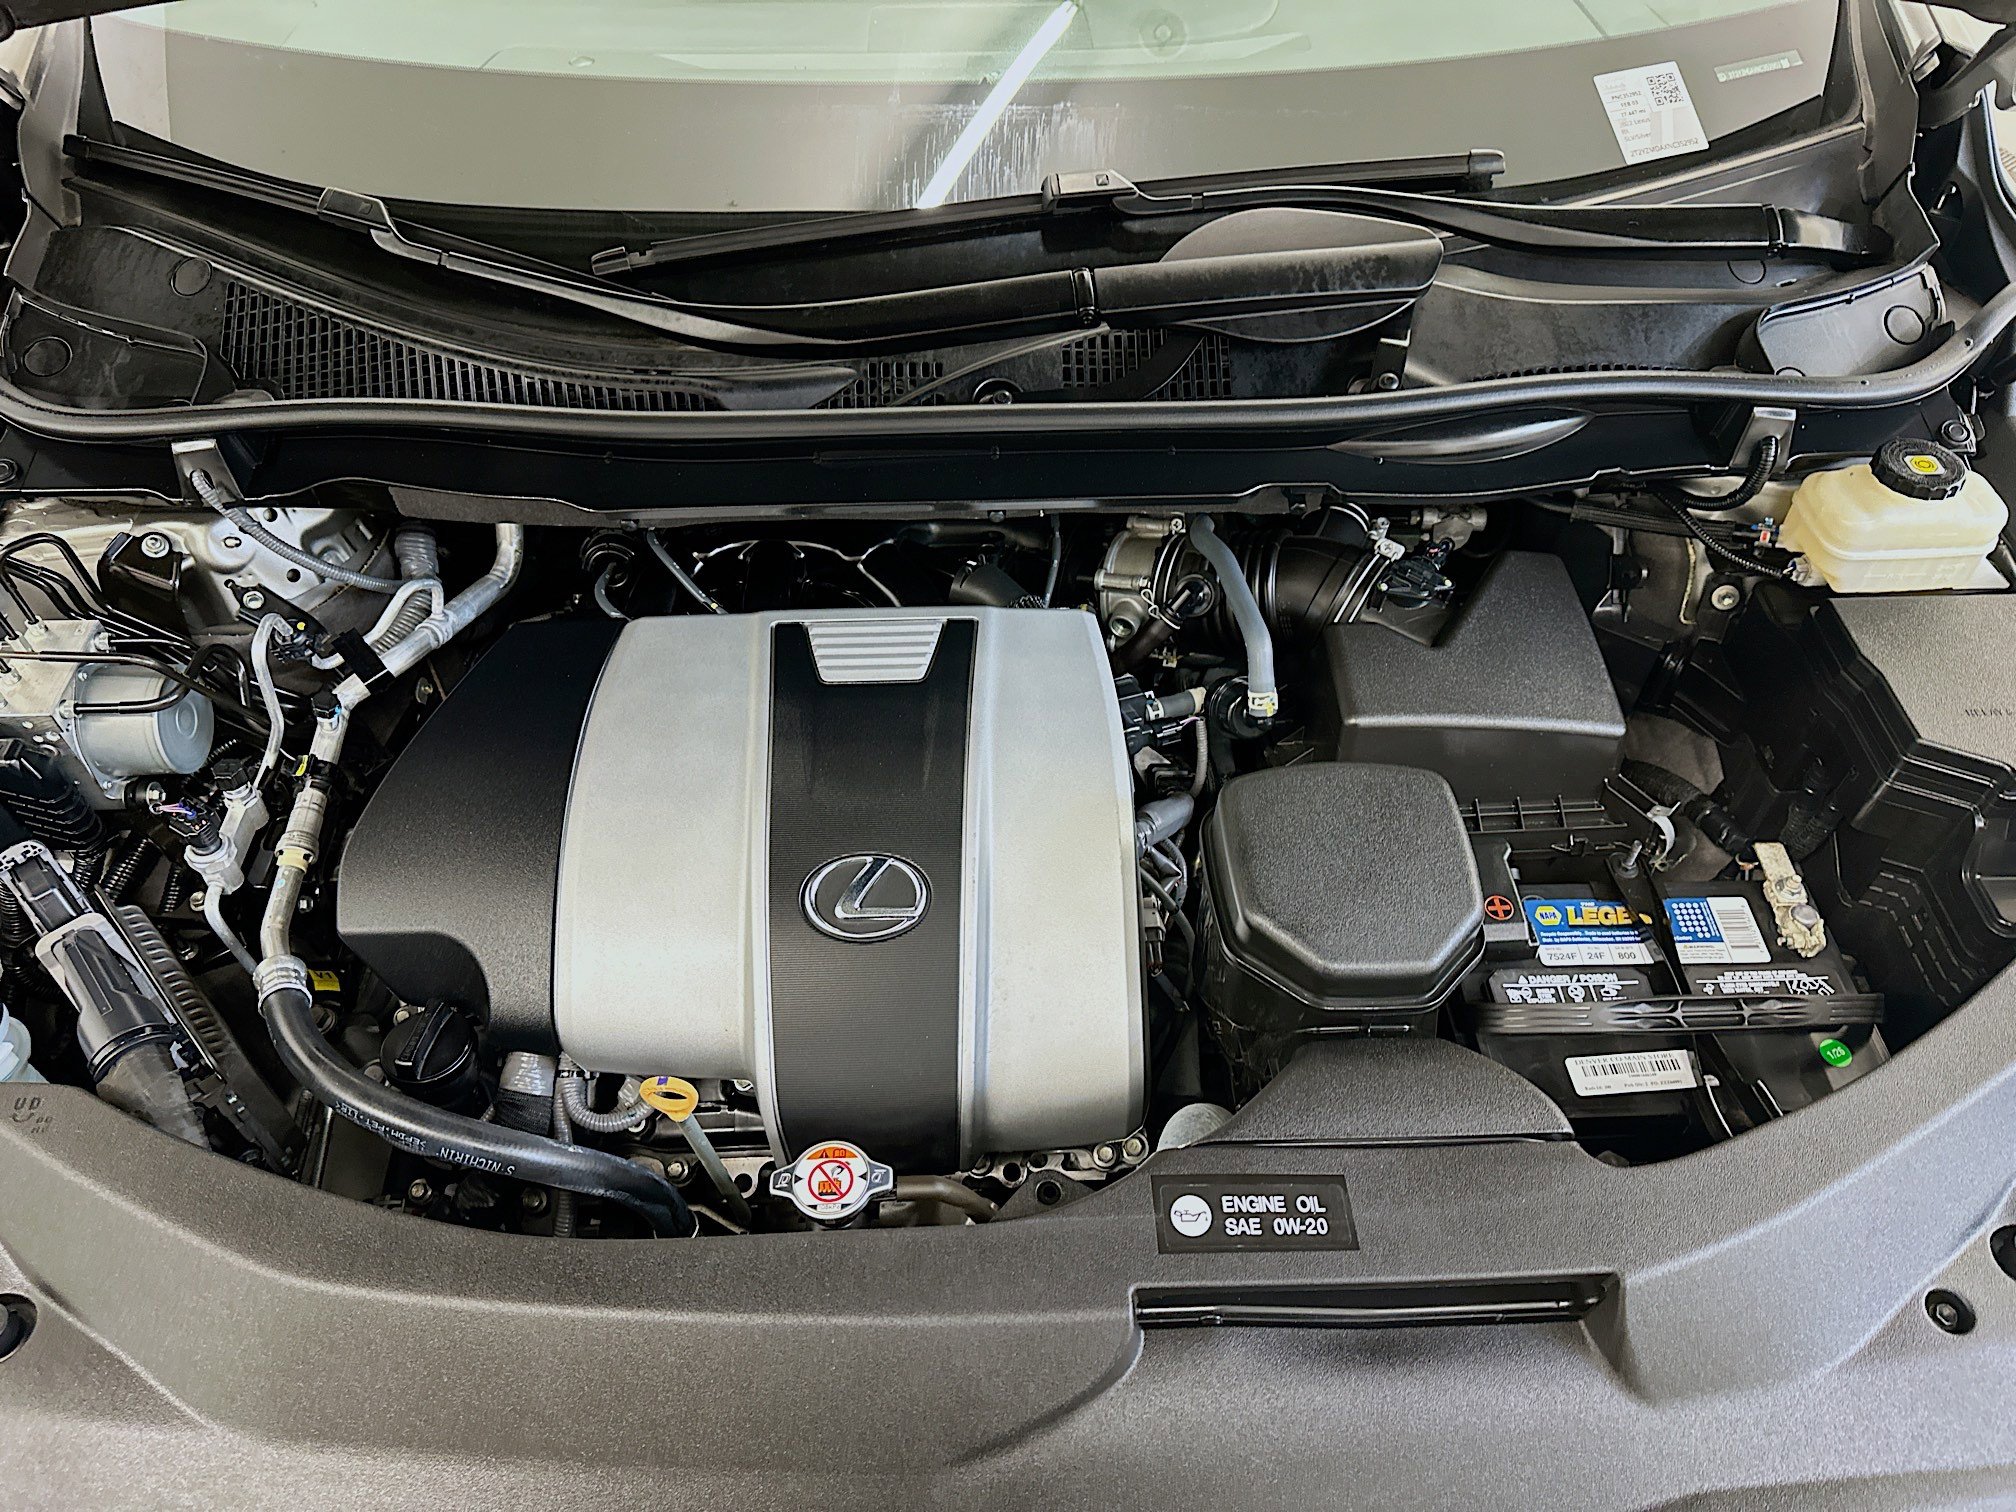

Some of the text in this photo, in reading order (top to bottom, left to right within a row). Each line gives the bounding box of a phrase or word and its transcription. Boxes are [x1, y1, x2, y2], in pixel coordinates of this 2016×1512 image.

[1539, 911, 1558, 921] NAPA
[1547, 951, 1636, 961] 7524F 24F 800
[1528, 974, 1571, 984] DANGER
[1579, 973, 1618, 983] POISON
[1826, 1046, 1846, 1060] 1/26
[1574, 1057, 1609, 1066] DENVER
[1221, 1195, 1326, 1213] ENGINE OIL
[1224, 1217, 1328, 1235] SAE 0W-20
